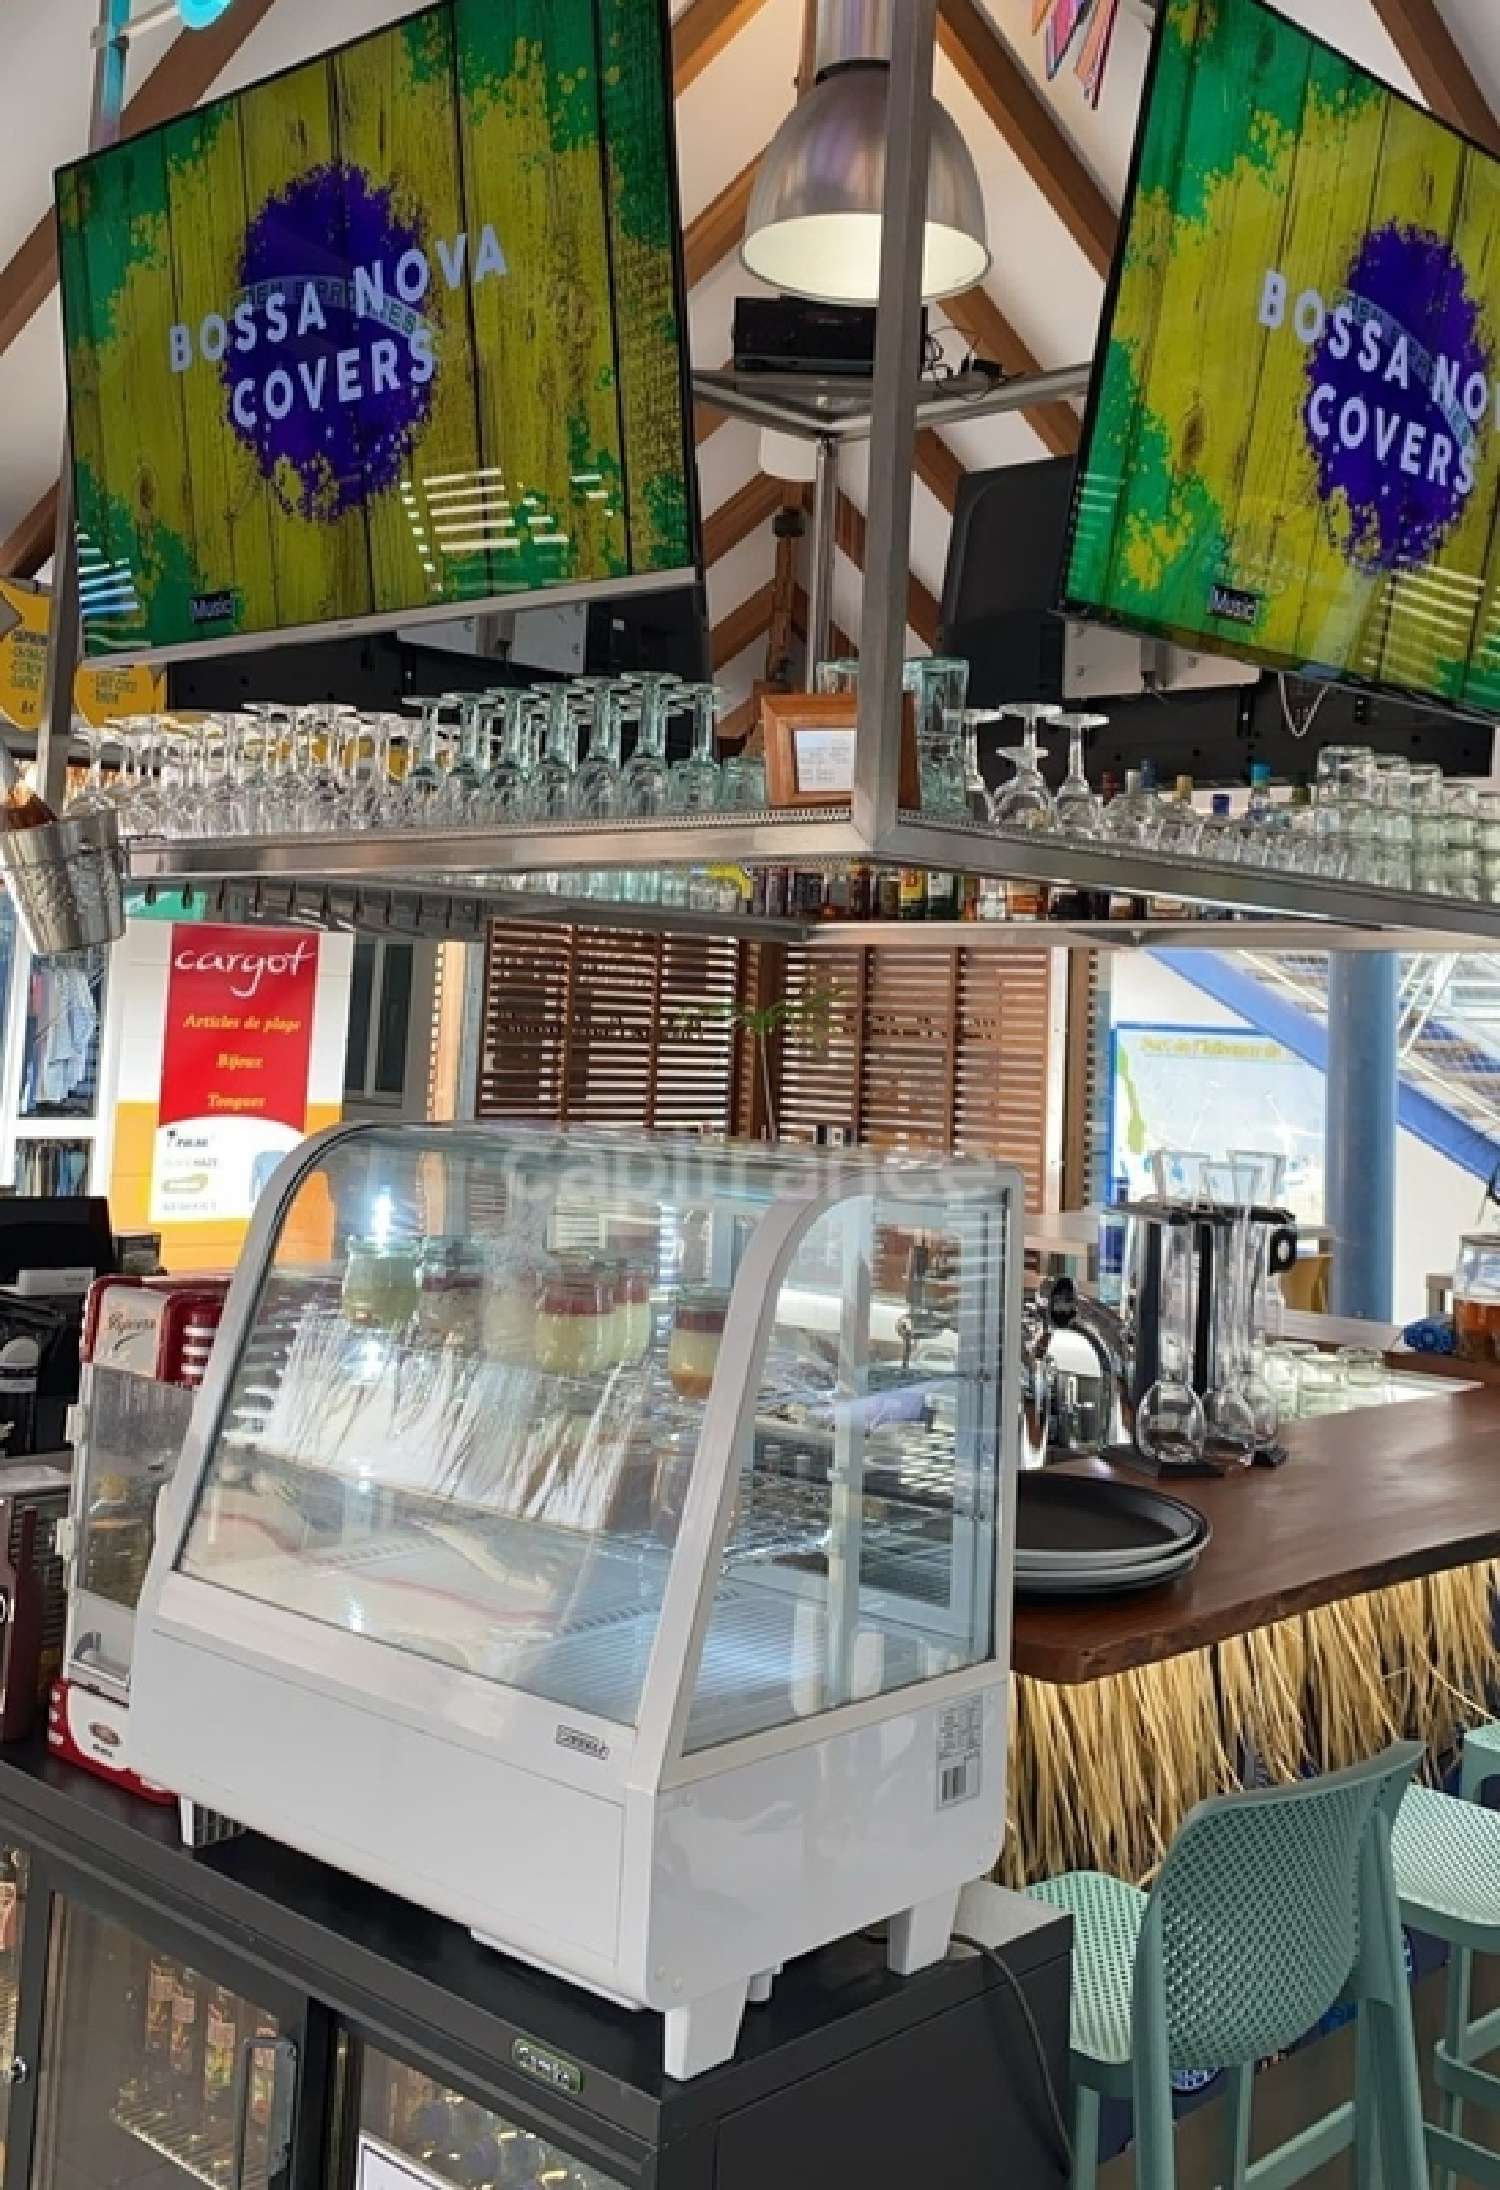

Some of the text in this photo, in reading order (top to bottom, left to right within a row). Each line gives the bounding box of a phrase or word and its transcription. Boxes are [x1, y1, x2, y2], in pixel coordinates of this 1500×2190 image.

[169, 281, 327, 373] BOSSA
[353, 224, 507, 318] NOVA
[1257, 269, 1500, 432] BOSSA NO
[232, 327, 433, 427] COVERS
[1310, 383, 1474, 495] COVERS
[174, 940, 316, 997] cargot
[182, 1014, 240, 1030] Articles
